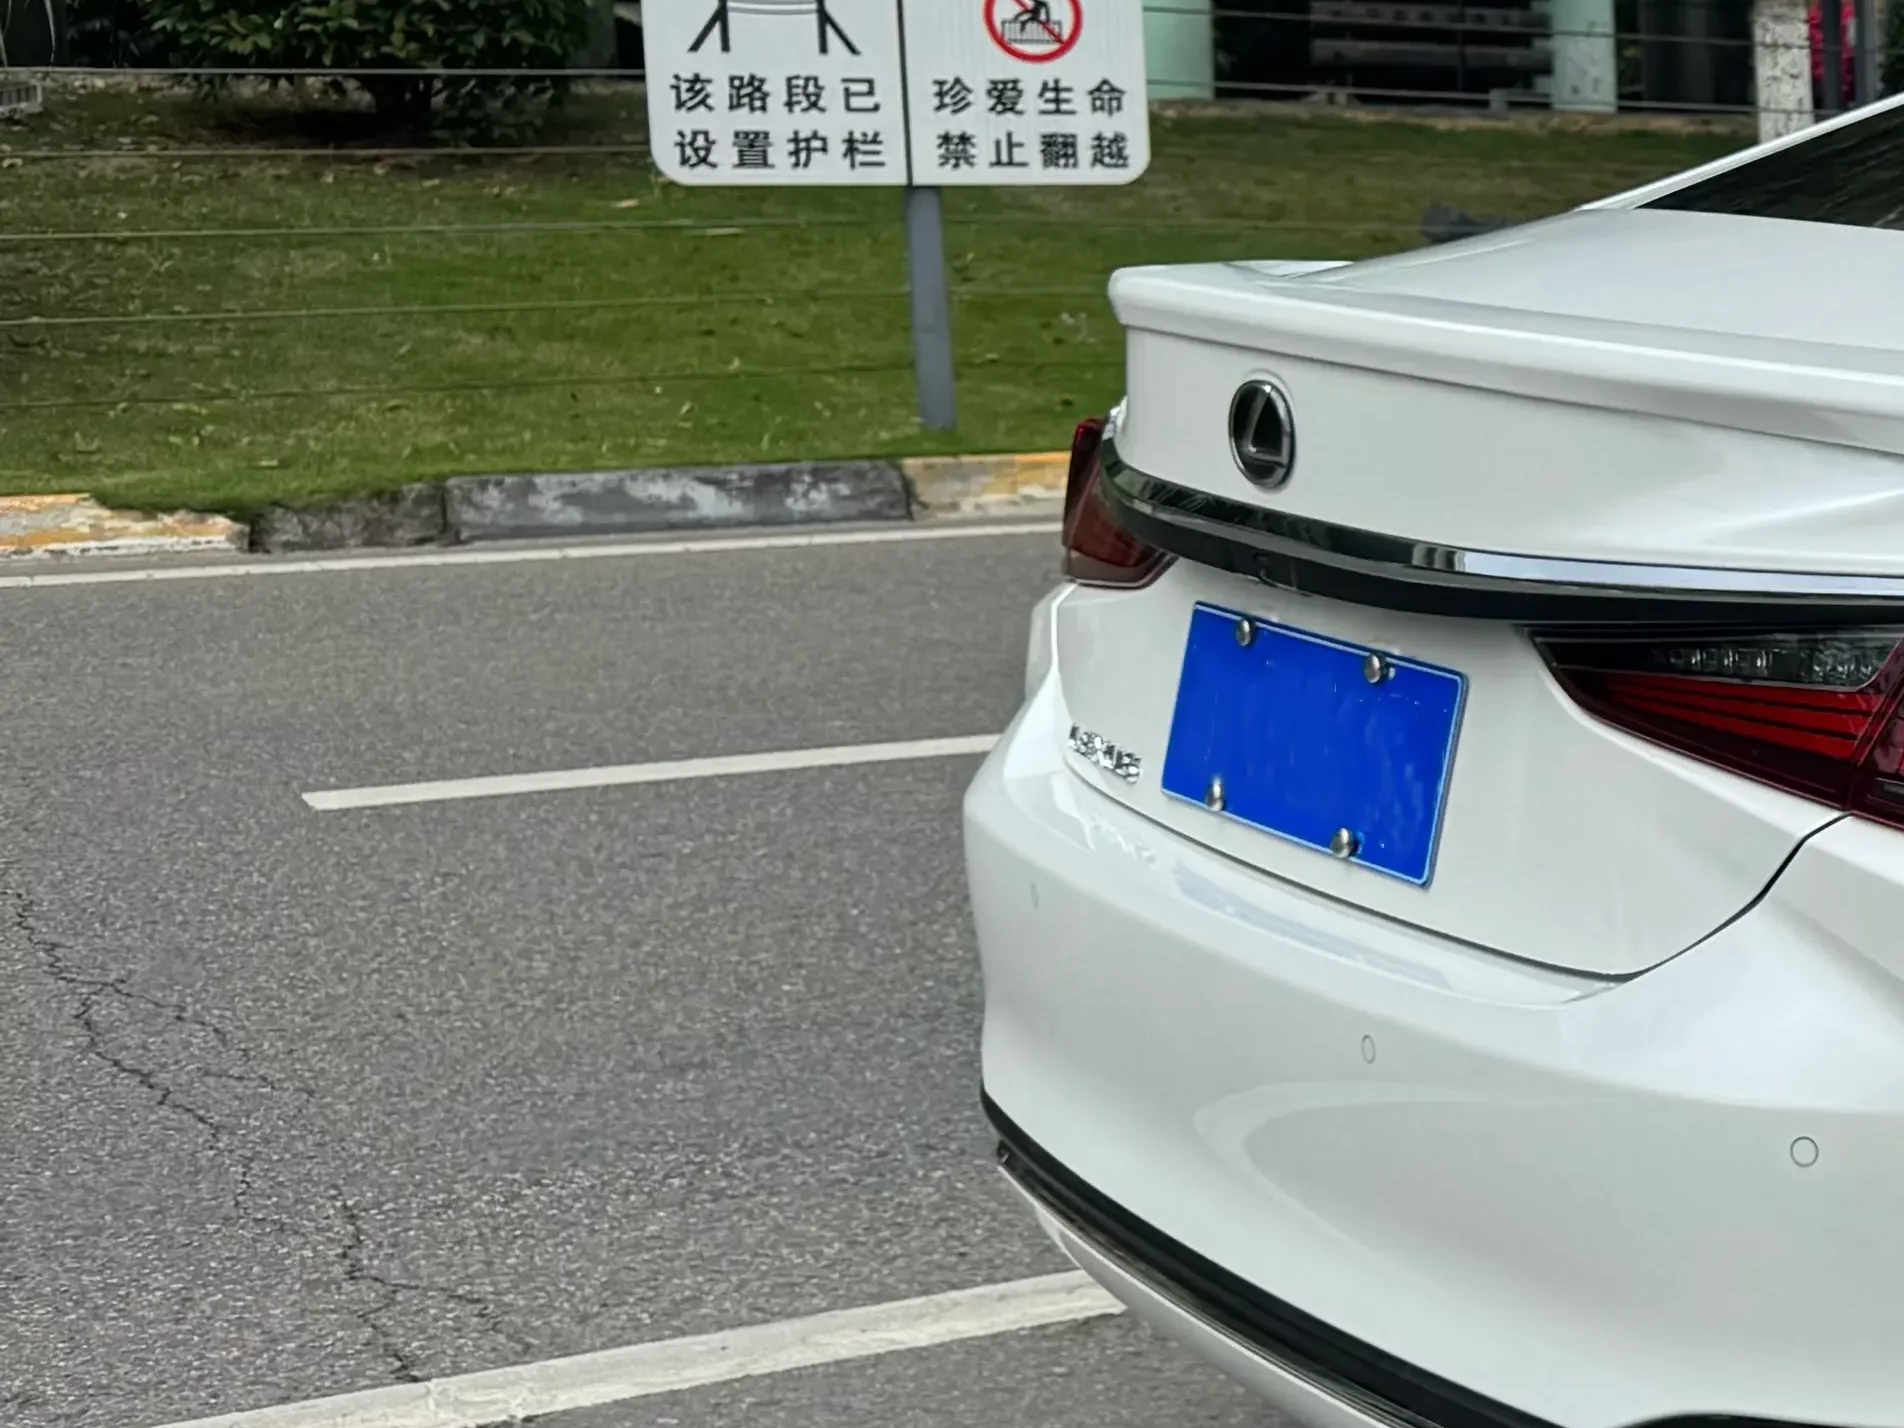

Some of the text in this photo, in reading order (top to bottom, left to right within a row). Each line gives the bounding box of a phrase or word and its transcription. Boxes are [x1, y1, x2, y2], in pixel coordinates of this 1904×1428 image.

[669, 72, 881, 114] 该路段已
[932, 76, 1126, 116] 珍爱生命
[673, 129, 886, 171] 设置护栏
[937, 131, 1129, 170] 禁止翻越
